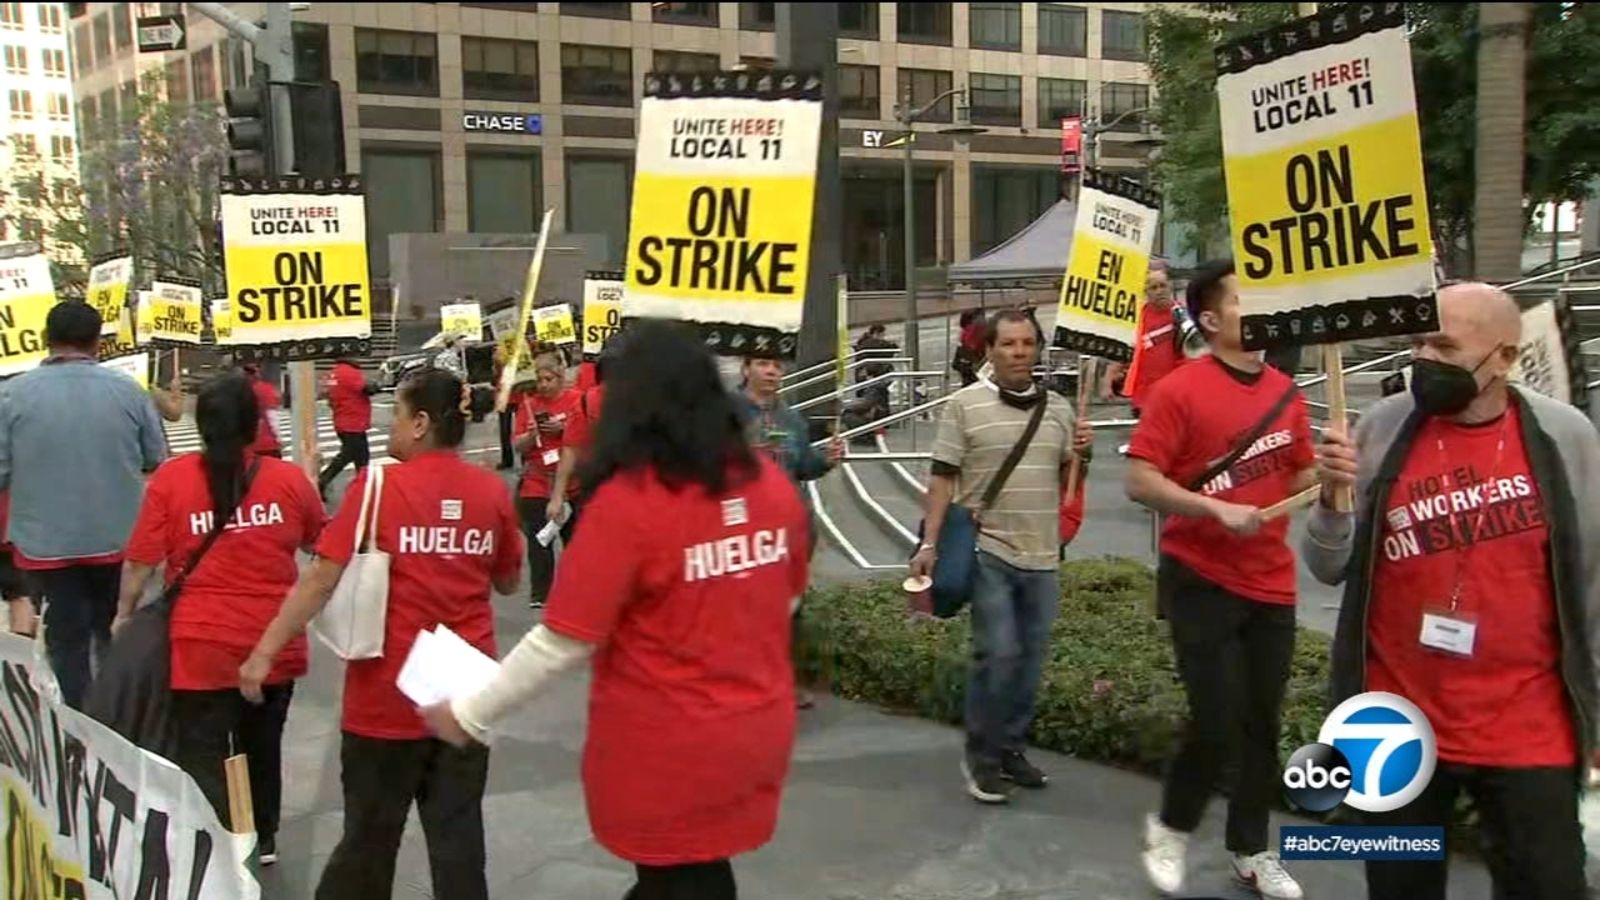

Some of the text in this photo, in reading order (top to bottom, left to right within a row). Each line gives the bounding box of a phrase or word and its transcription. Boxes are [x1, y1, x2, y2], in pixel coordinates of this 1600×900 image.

[1252, 58, 1370, 107] UNITE HERE!
[463, 114, 524, 131] CHASE
[1254, 81, 1374, 133] LOCAL 11
[673, 118, 785, 136] UNITE HERE!
[862, 131, 884, 147] EY
[669, 137, 782, 160] LOCAL 11
[1286, 145, 1354, 214] ON
[250, 206, 338, 219] UNITE HERE!
[251, 220, 340, 235] LOCAL 11
[687, 186, 751, 238] ON
[1092, 213, 1127, 239] LOCAL
[1241, 194, 1419, 280] STRIKE
[274, 251, 324, 286] ON
[635, 236, 798, 294] STRIKE
[1096, 249, 1124, 284] EN
[168, 305, 185, 319] ON
[237, 284, 363, 323] STRIKE
[1063, 275, 1138, 323] HUELGA
[153, 317, 198, 335] STRIKE
[1411, 475, 1531, 522] WORKERS
[400, 527, 494, 554] HUELGA
[684, 527, 789, 582] HUELGA
[1384, 530, 1421, 562] ON
